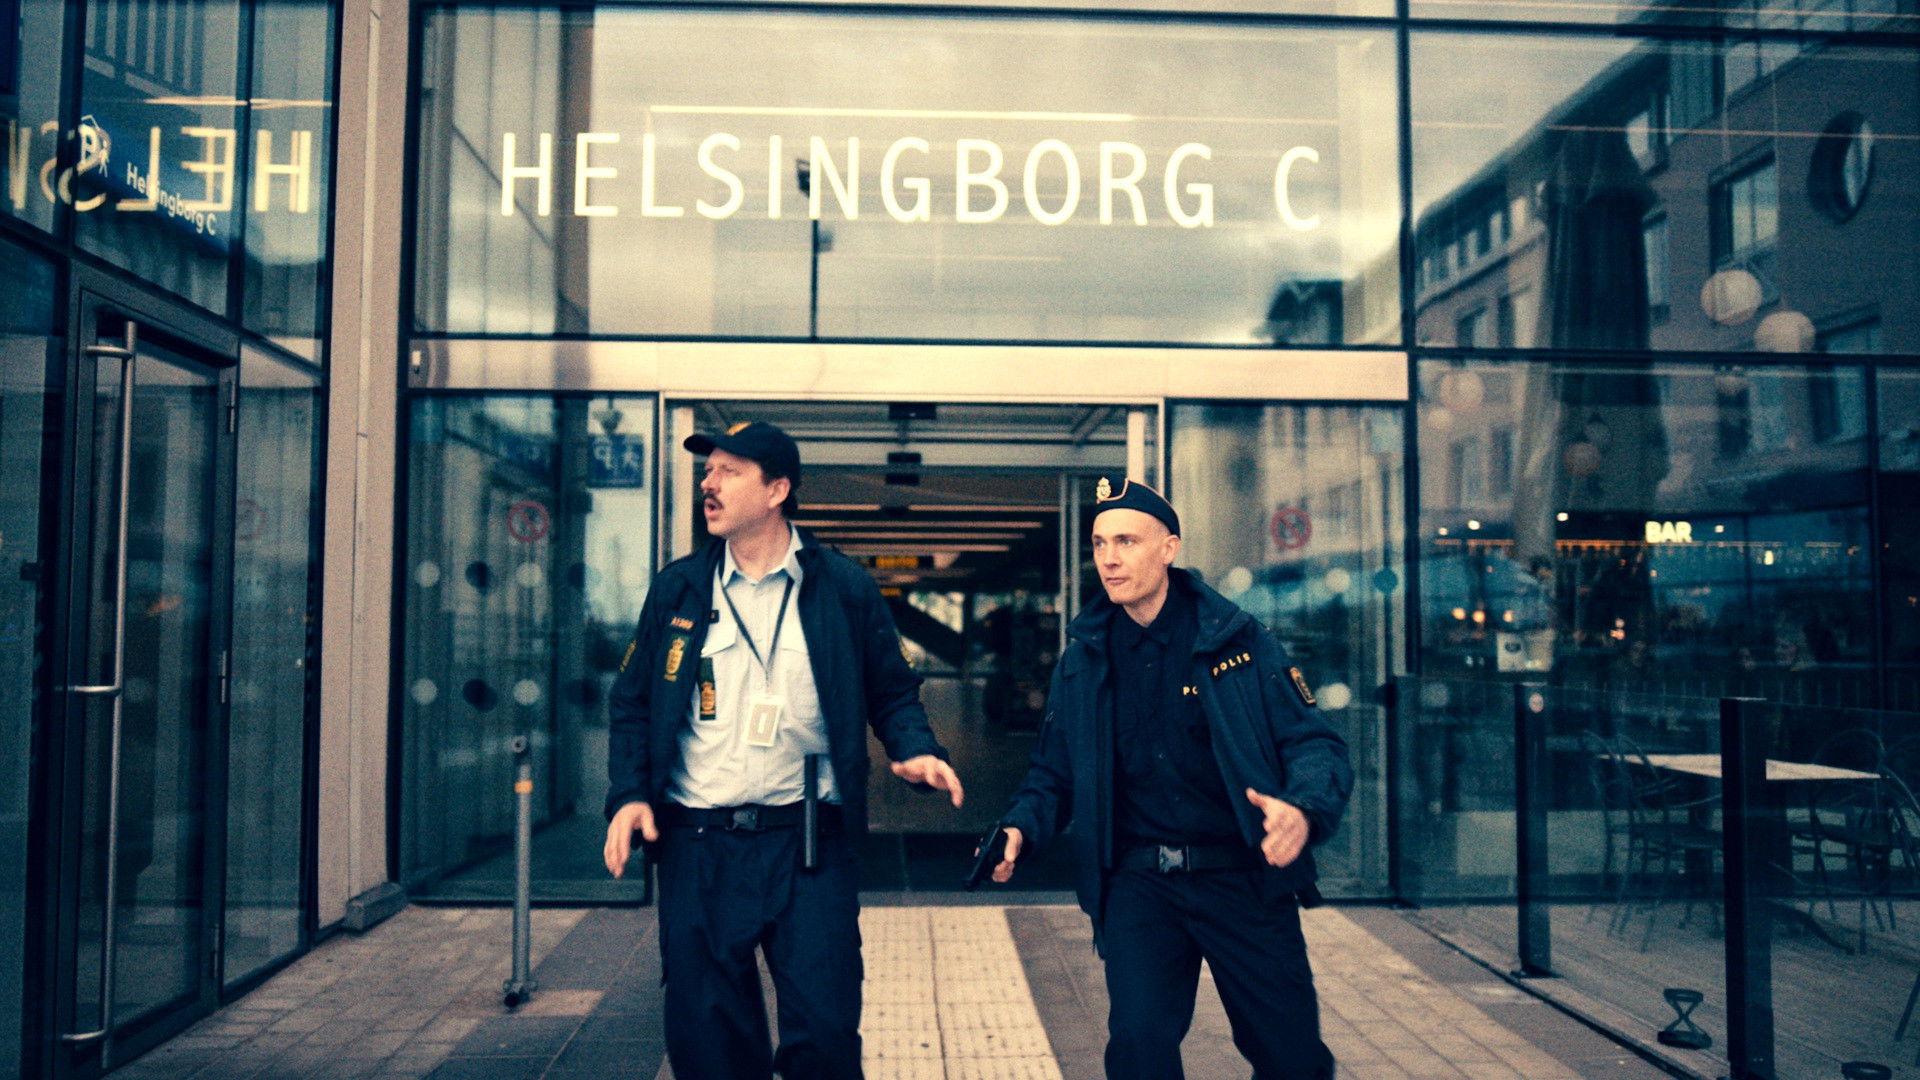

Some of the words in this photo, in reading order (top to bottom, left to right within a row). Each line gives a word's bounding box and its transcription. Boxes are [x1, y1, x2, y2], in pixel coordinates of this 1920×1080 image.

[502, 132, 1214, 229] HELSINGBORG
[1274, 145, 1321, 231] C
[206, 213, 217, 236] C
[1646, 521, 1692, 543] BAR
[1213, 653, 1250, 676] POLIS
